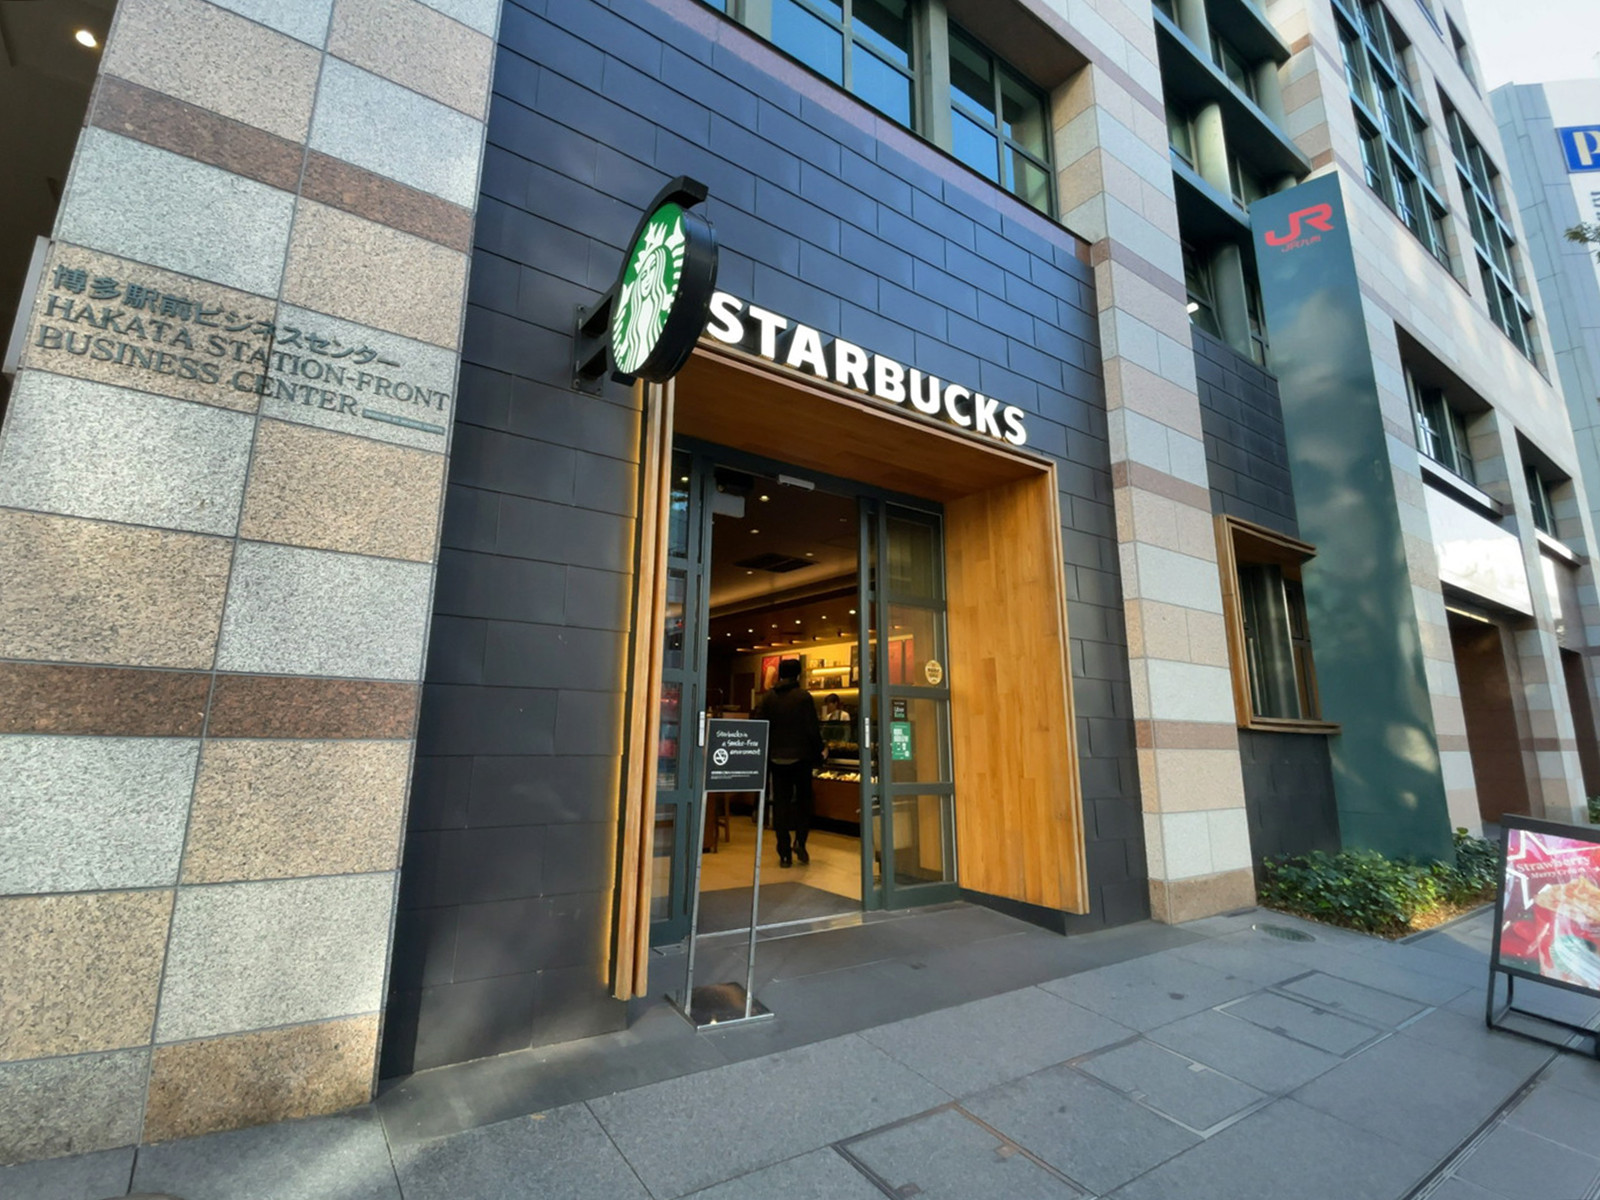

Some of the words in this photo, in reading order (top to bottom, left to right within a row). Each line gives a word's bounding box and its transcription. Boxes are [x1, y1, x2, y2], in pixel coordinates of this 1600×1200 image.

[1264, 203, 1334, 246] JR
[44, 294, 193, 350] HAKATA
[206, 334, 450, 410] STATION-FRONT
[53, 264, 400, 367] 博多駅前ビジネスセンター
[35, 324, 219, 385] BUSINESS
[231, 370, 358, 416] CENTER
[706, 291, 1027, 446] STARBUCKS
